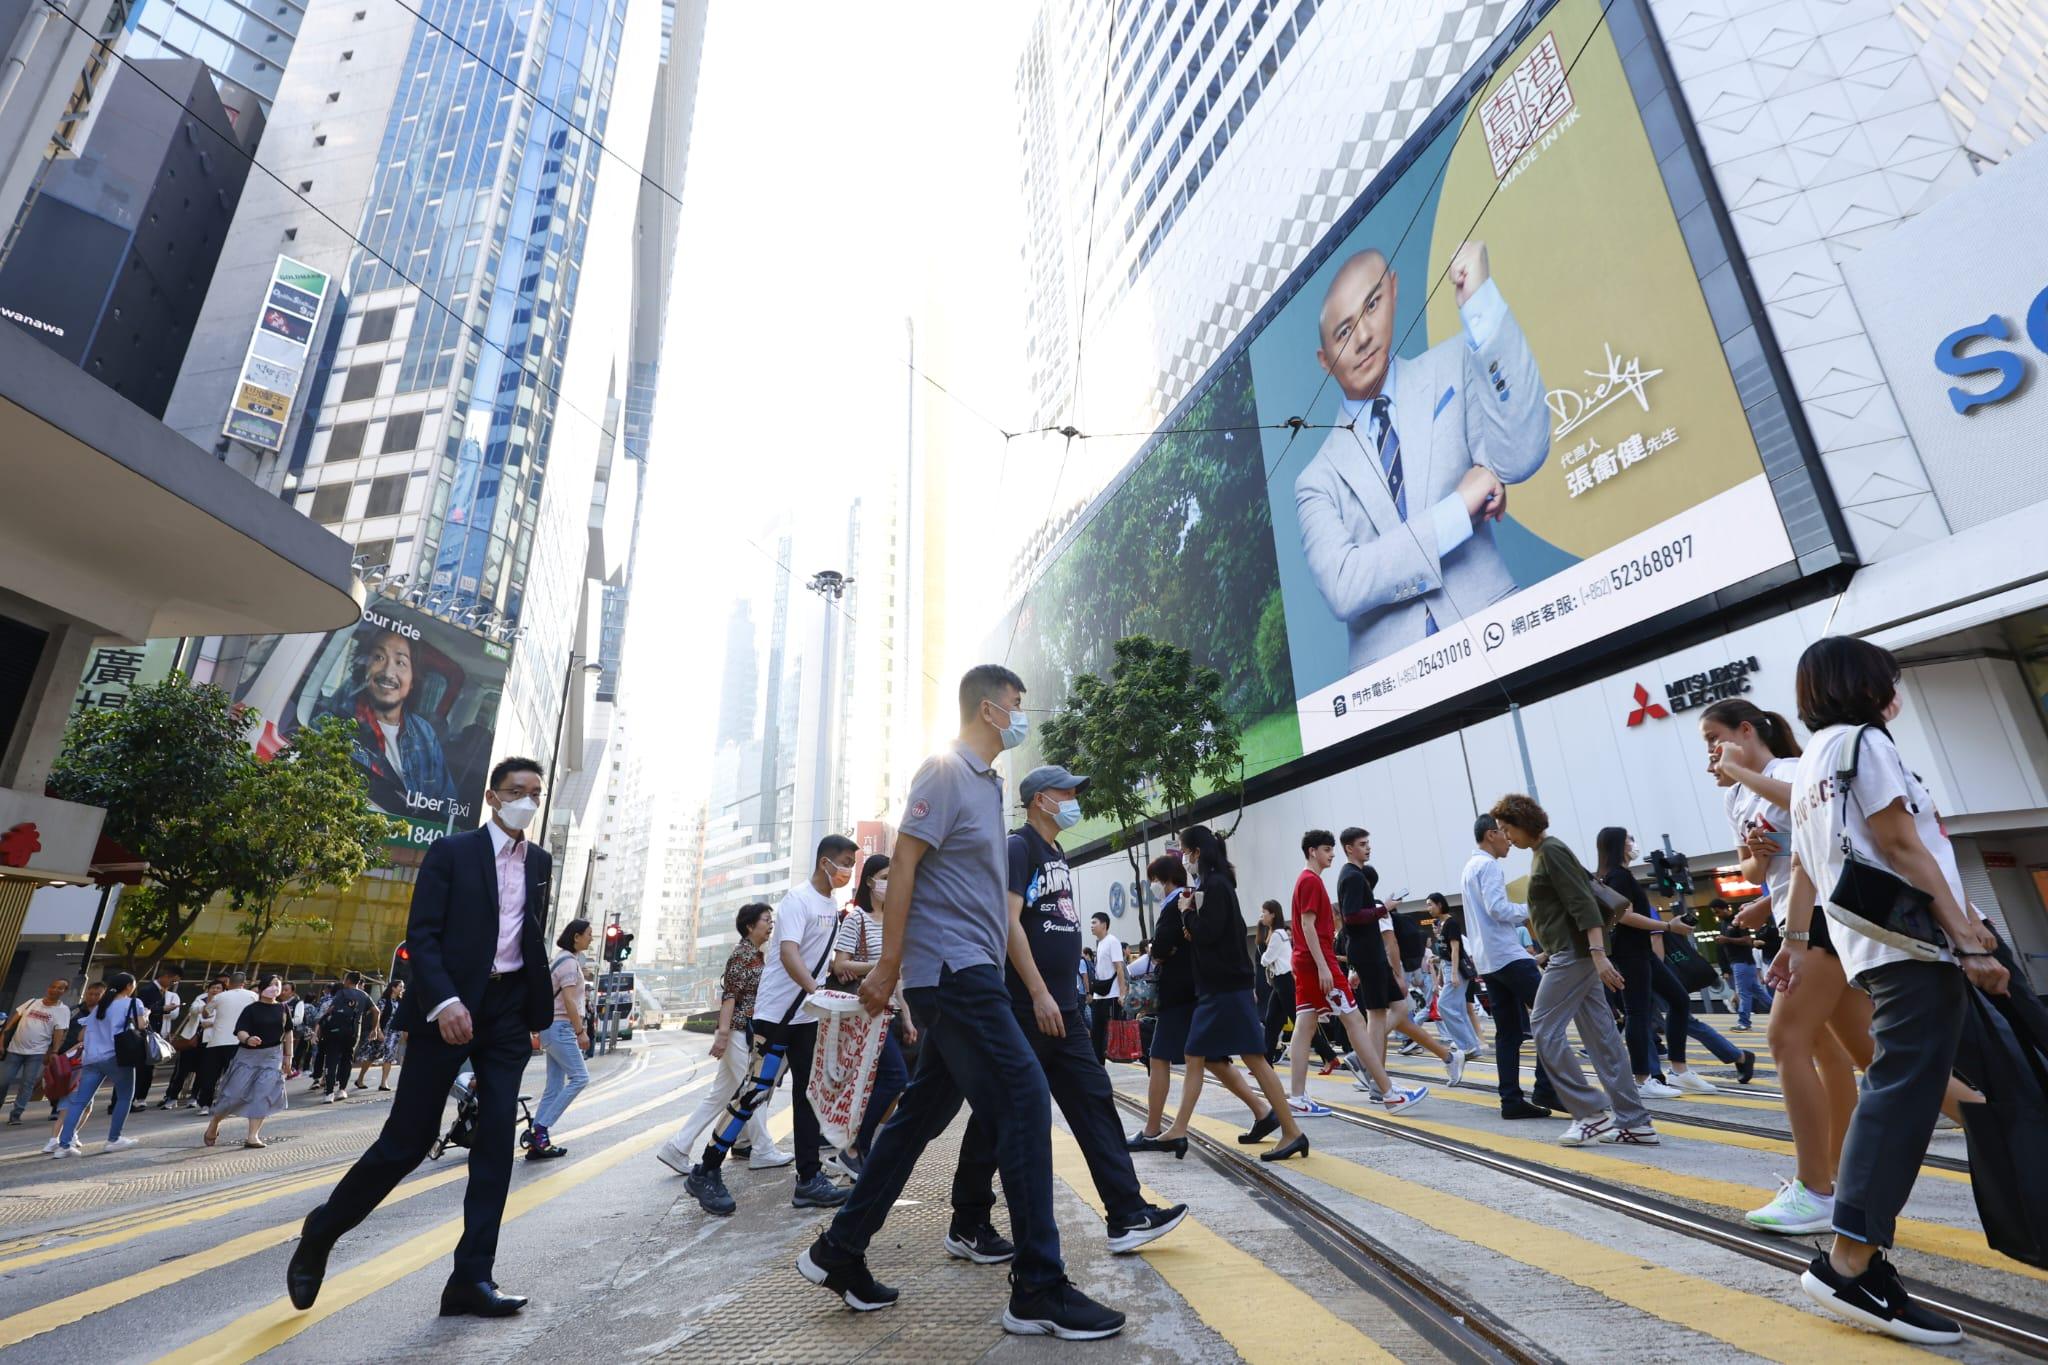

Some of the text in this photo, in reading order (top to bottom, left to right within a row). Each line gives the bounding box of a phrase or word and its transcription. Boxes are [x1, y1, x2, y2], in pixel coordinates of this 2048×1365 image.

[1498, 107, 1581, 192] MADE IN HK
[0, 306, 65, 337] wanawa
[1610, 534, 1695, 591] 52368897
[391, 621, 421, 641] ride
[1417, 638, 1472, 677] 25431018
[1664, 655, 1760, 698] MITSUBISHI
[1669, 677, 1752, 713] ELECTRIC
[406, 789, 471, 818] Uber Taxi
